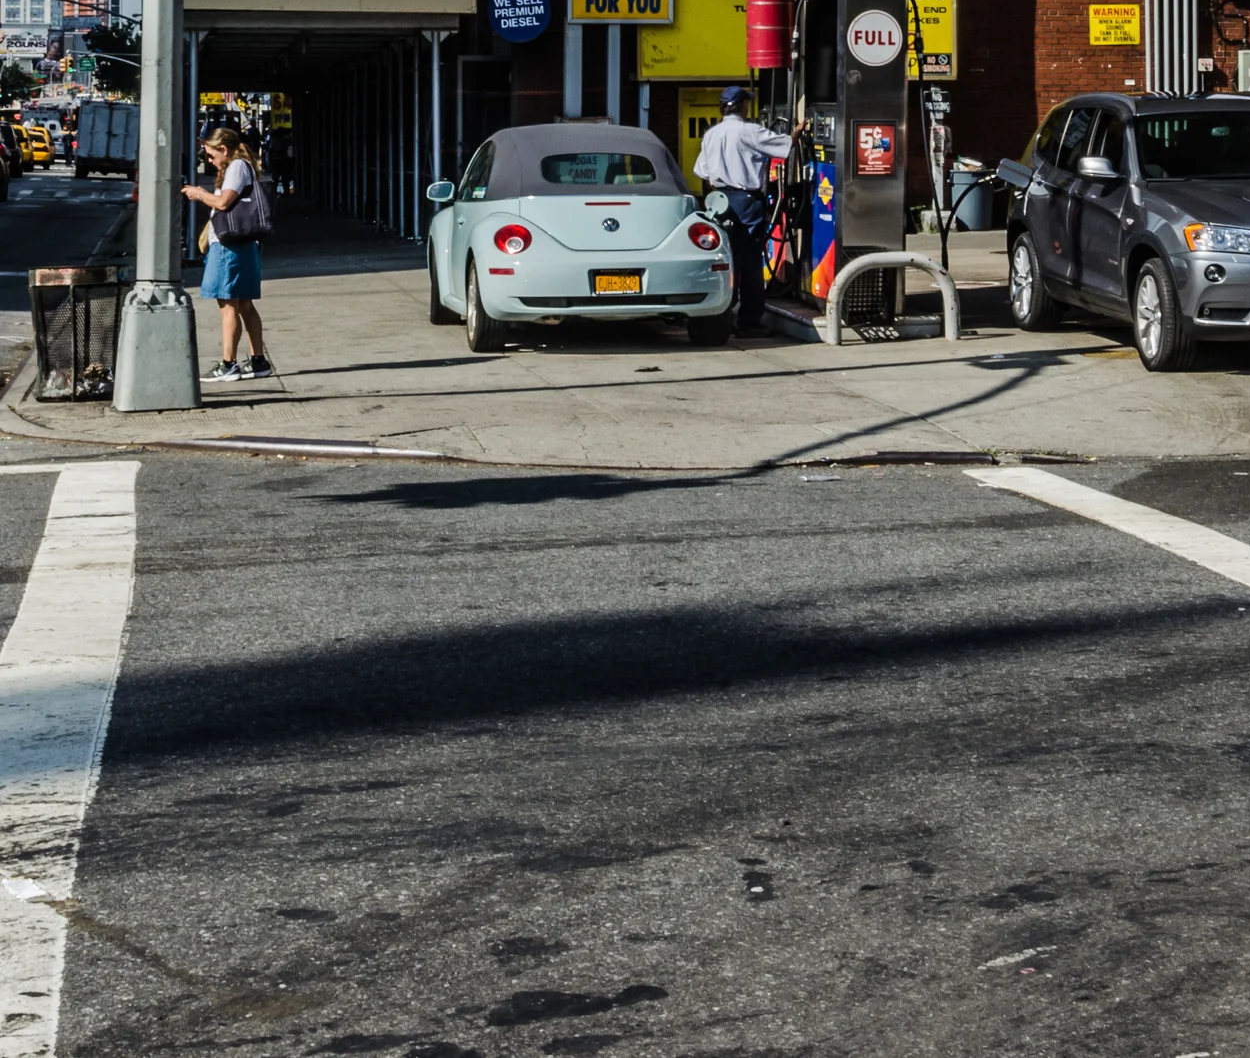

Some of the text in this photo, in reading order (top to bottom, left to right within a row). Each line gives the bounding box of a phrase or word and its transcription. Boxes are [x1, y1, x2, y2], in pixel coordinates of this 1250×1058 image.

[494, 5, 544, 18] PREMIUM
[924, 6, 947, 14] END
[1093, 8, 1136, 16] WARNING
[501, 16, 540, 28] DIESEL
[854, 30, 896, 46] FULL
